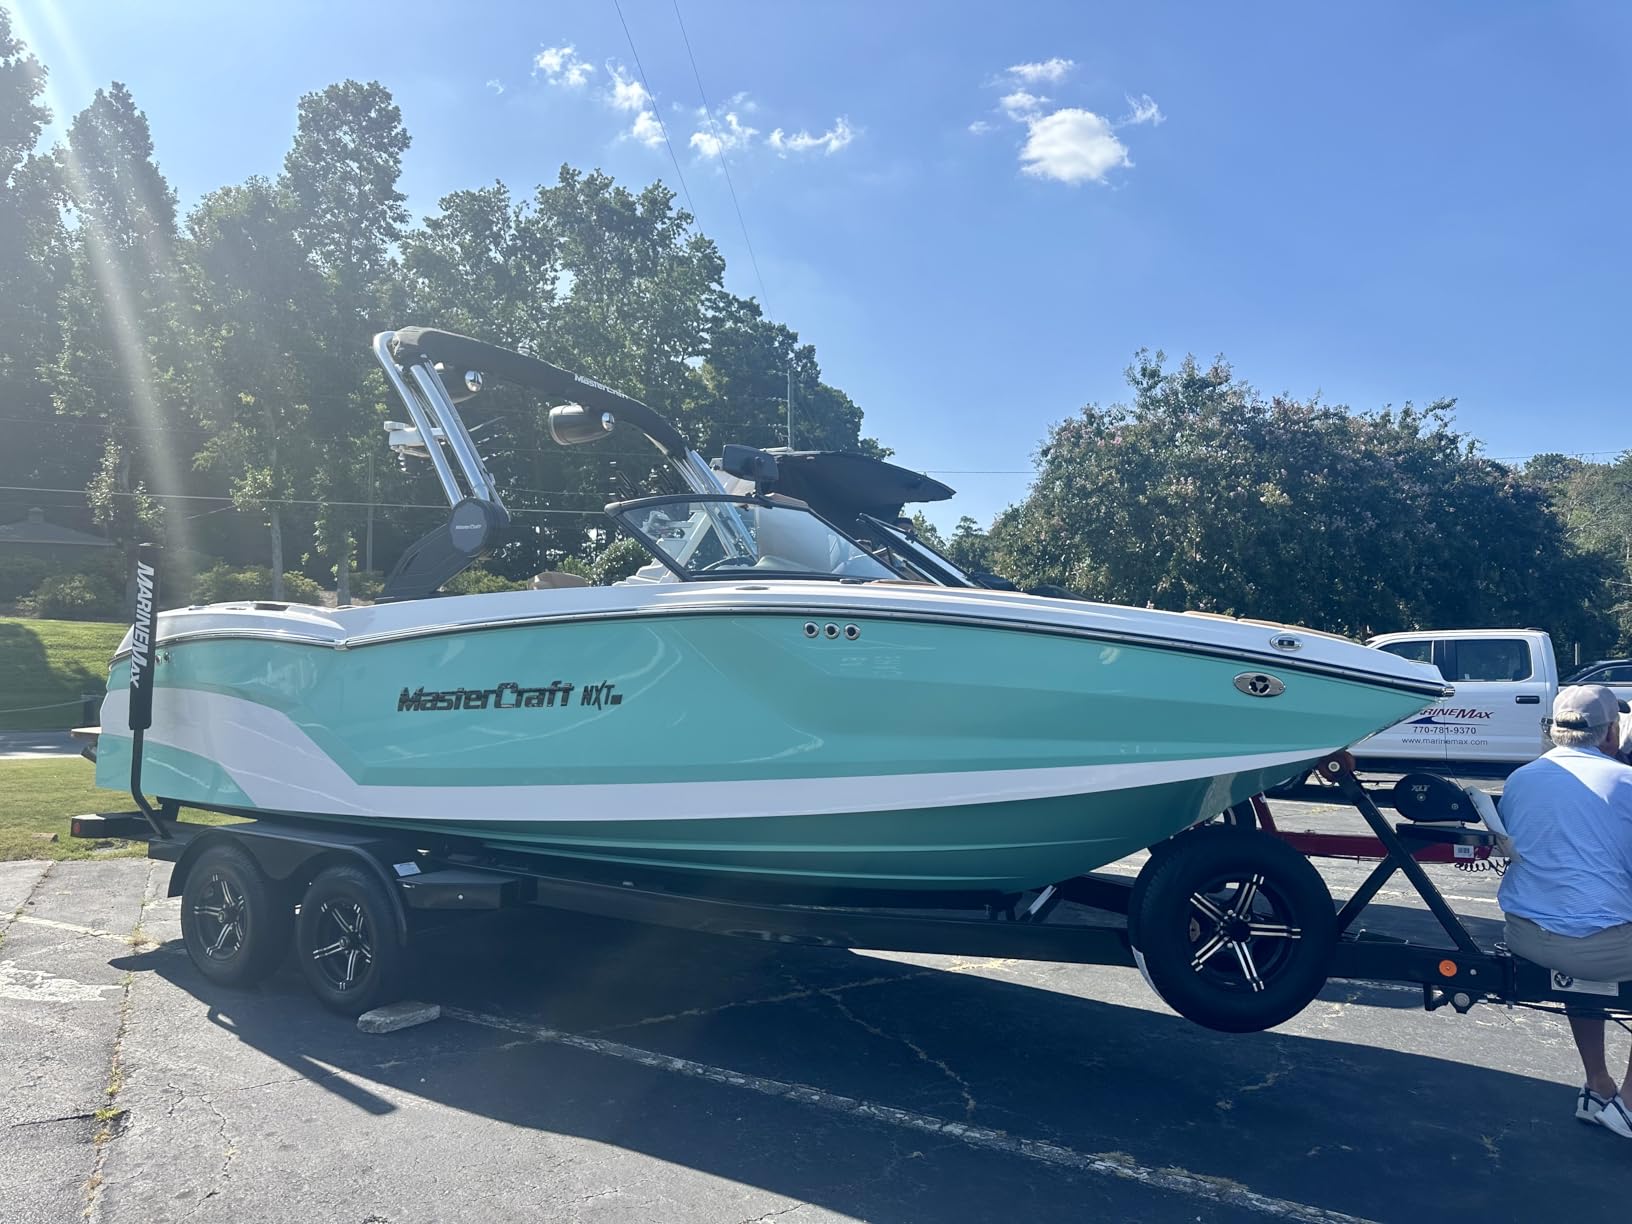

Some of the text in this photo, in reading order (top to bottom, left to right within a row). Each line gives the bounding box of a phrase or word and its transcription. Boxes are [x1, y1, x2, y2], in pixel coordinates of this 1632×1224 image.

[130, 560, 155, 688] MARINEMAX
[397, 680, 574, 712] MasterCraft
[1420, 708, 1495, 719] RINEMAX
[1413, 726, 1477, 735] 770-781-9370
[1401, 737, 1488, 746] www.marinemax.com
